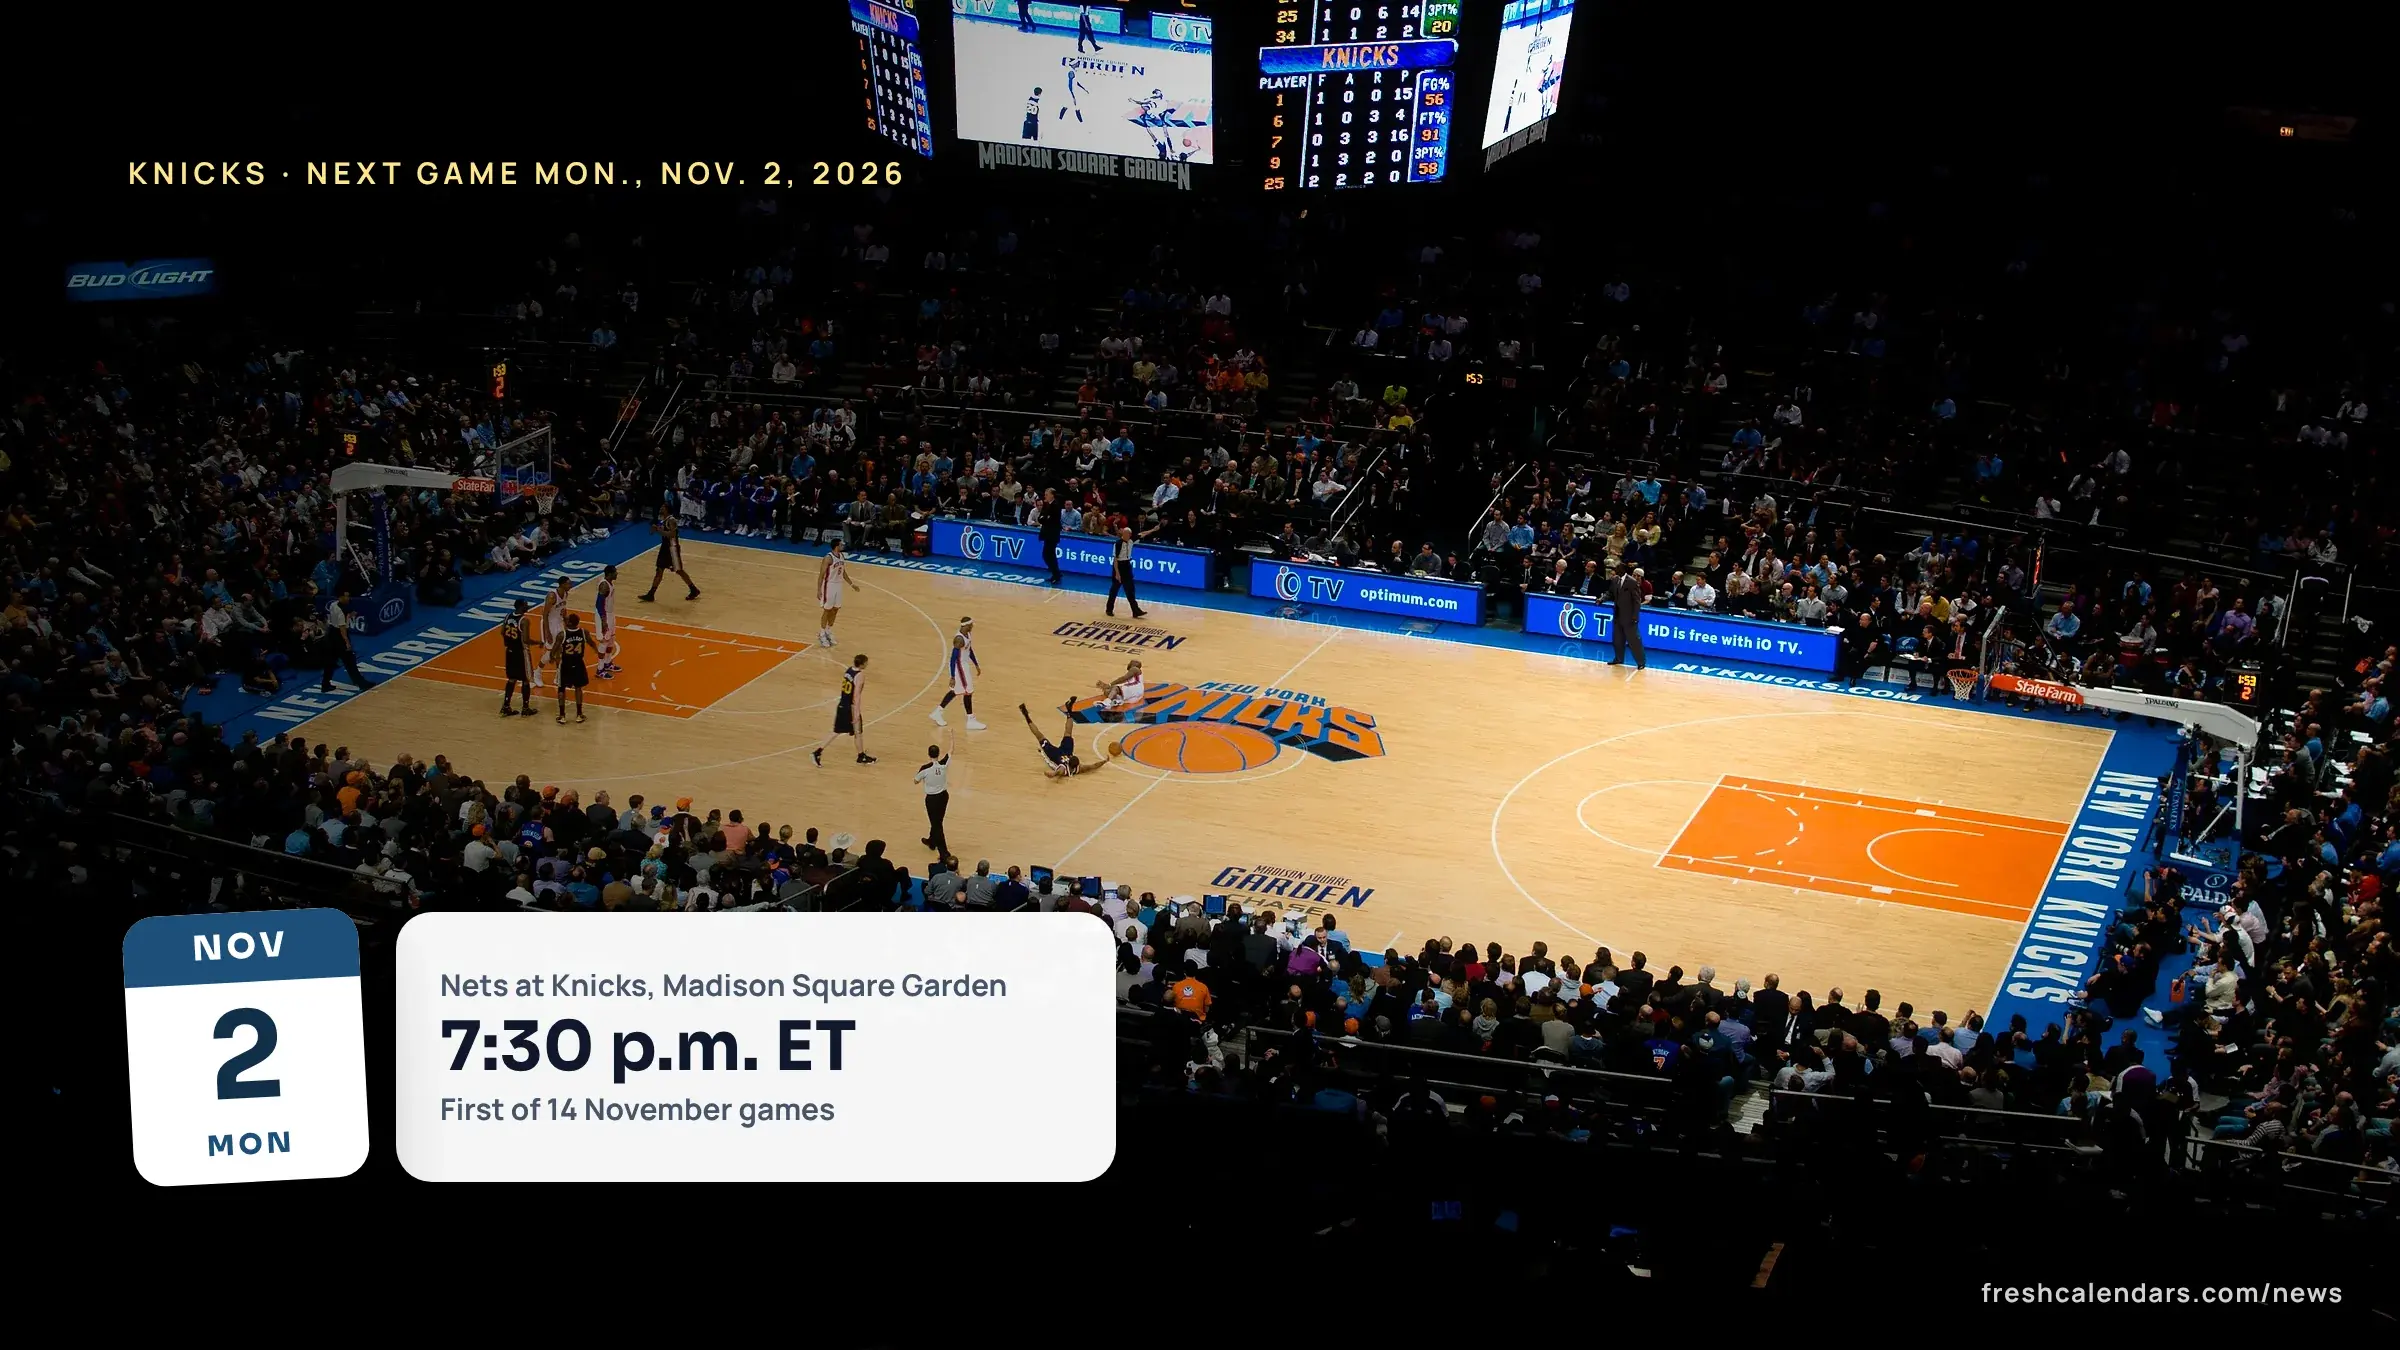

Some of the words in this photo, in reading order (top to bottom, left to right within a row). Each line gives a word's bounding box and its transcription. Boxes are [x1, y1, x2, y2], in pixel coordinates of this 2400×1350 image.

[869, 3, 898, 32] KNICKS
[1277, 10, 1298, 24] 25
[1324, 8, 1332, 22] 1
[1350, 8, 1361, 20] 0
[1378, 6, 1388, 20] 6
[1402, 5, 1420, 18] 14
[1428, 4, 1458, 17] 3PT%
[1276, 30, 1296, 44] 34
[1322, 28, 1330, 41] 1
[1350, 27, 1358, 40] 1
[1376, 26, 1387, 39] 2
[1402, 25, 1414, 38] 2
[1432, 20, 1452, 33] 20
[1322, 45, 1399, 69] KNICKS
[1260, 76, 1306, 90] PLAYER
[1318, 74, 1326, 86] F
[1345, 73, 1354, 85] A
[1374, 72, 1382, 84] R
[1402, 70, 1409, 82] P
[1422, 78, 1450, 92] FG%
[1276, 94, 1284, 106] 1
[1316, 92, 1324, 104] 1
[1344, 90, 1354, 103] 0
[1371, 89, 1382, 102] 0
[1395, 88, 1413, 100] 15
[1425, 93, 1444, 106] 56
[1273, 115, 1283, 128] 6
[1315, 112, 1322, 126] 1
[1342, 111, 1352, 124] 0
[1369, 110, 1380, 122] 3
[1396, 108, 1405, 121] 4
[1420, 112, 1446, 126] FT%
[1272, 136, 1282, 148] 7
[1312, 134, 1322, 146] 0
[1340, 132, 1350, 144] 3
[1367, 130, 1378, 143] 3
[1390, 128, 1408, 142] 16
[1421, 128, 1440, 142] 91
[978, 142, 1052, 170] MADISON
[1058, 152, 1118, 176] SQUARE
[1124, 158, 1192, 190] GARDEN
[1270, 156, 1280, 169] 9
[1312, 154, 1319, 167] 1
[1338, 152, 1348, 166] 3
[1366, 151, 1376, 164] 2
[1392, 150, 1402, 162] 0
[1415, 146, 1444, 160] 3PT%
[1264, 177, 1284, 190] 25
[1308, 176, 1320, 188] 2
[1336, 174, 1346, 186] 2
[1364, 172, 1374, 184] 2
[1390, 170, 1400, 183] 0
[1418, 162, 1438, 176] 58
[67, 274, 126, 288] BUD
[138, 270, 214, 284] LIGHT
[496, 377, 504, 398] 2
[457, 479, 496, 492] StateFar
[990, 535, 1025, 560] TV
[1066, 548, 1077, 561] is
[1080, 550, 1106, 565] free
[1159, 560, 1181, 574] TV.
[843, 552, 1045, 586] NYKNICKS.COM
[458, 560, 608, 622] KNICKS
[1308, 576, 1344, 602] TV
[1360, 587, 1458, 611] optimum.com
[384, 601, 400, 619] KIA
[505, 624, 518, 640] 25
[1053, 622, 1187, 650] GARDEN
[1089, 620, 1133, 632] MADISON
[1133, 626, 1169, 636] SQUARE
[1594, 612, 1614, 636] T
[1648, 622, 1670, 638] HD
[1674, 626, 1686, 640] is
[1690, 628, 1718, 644] free
[1722, 633, 1752, 649] with
[1778, 640, 1803, 656] TV.
[345, 627, 477, 676] YORK
[565, 642, 582, 655] 24
[1062, 640, 1146, 656] CHASE
[1673, 662, 1922, 702] NYKNICKS.COM
[2014, 679, 2077, 703] StateFarm
[2238, 674, 2257, 687] 1:53
[254, 680, 360, 723] NEW
[1196, 681, 1260, 695] NEW
[1263, 686, 1327, 708] YORK
[2144, 697, 2180, 709] SPALDING
[2242, 686, 2252, 700] 2
[2088, 770, 2158, 820] NEW
[2055, 824, 2140, 889] YORK
[1211, 866, 1375, 908] GARDEN
[1253, 865, 1306, 880] MADISON
[1308, 873, 1351, 887] SQUARE
[1226, 894, 1328, 916] CHASE
[2181, 885, 2231, 905] PALD
[2006, 896, 2109, 1004] KNICKS
[1654, 1056, 1666, 1070] 7
